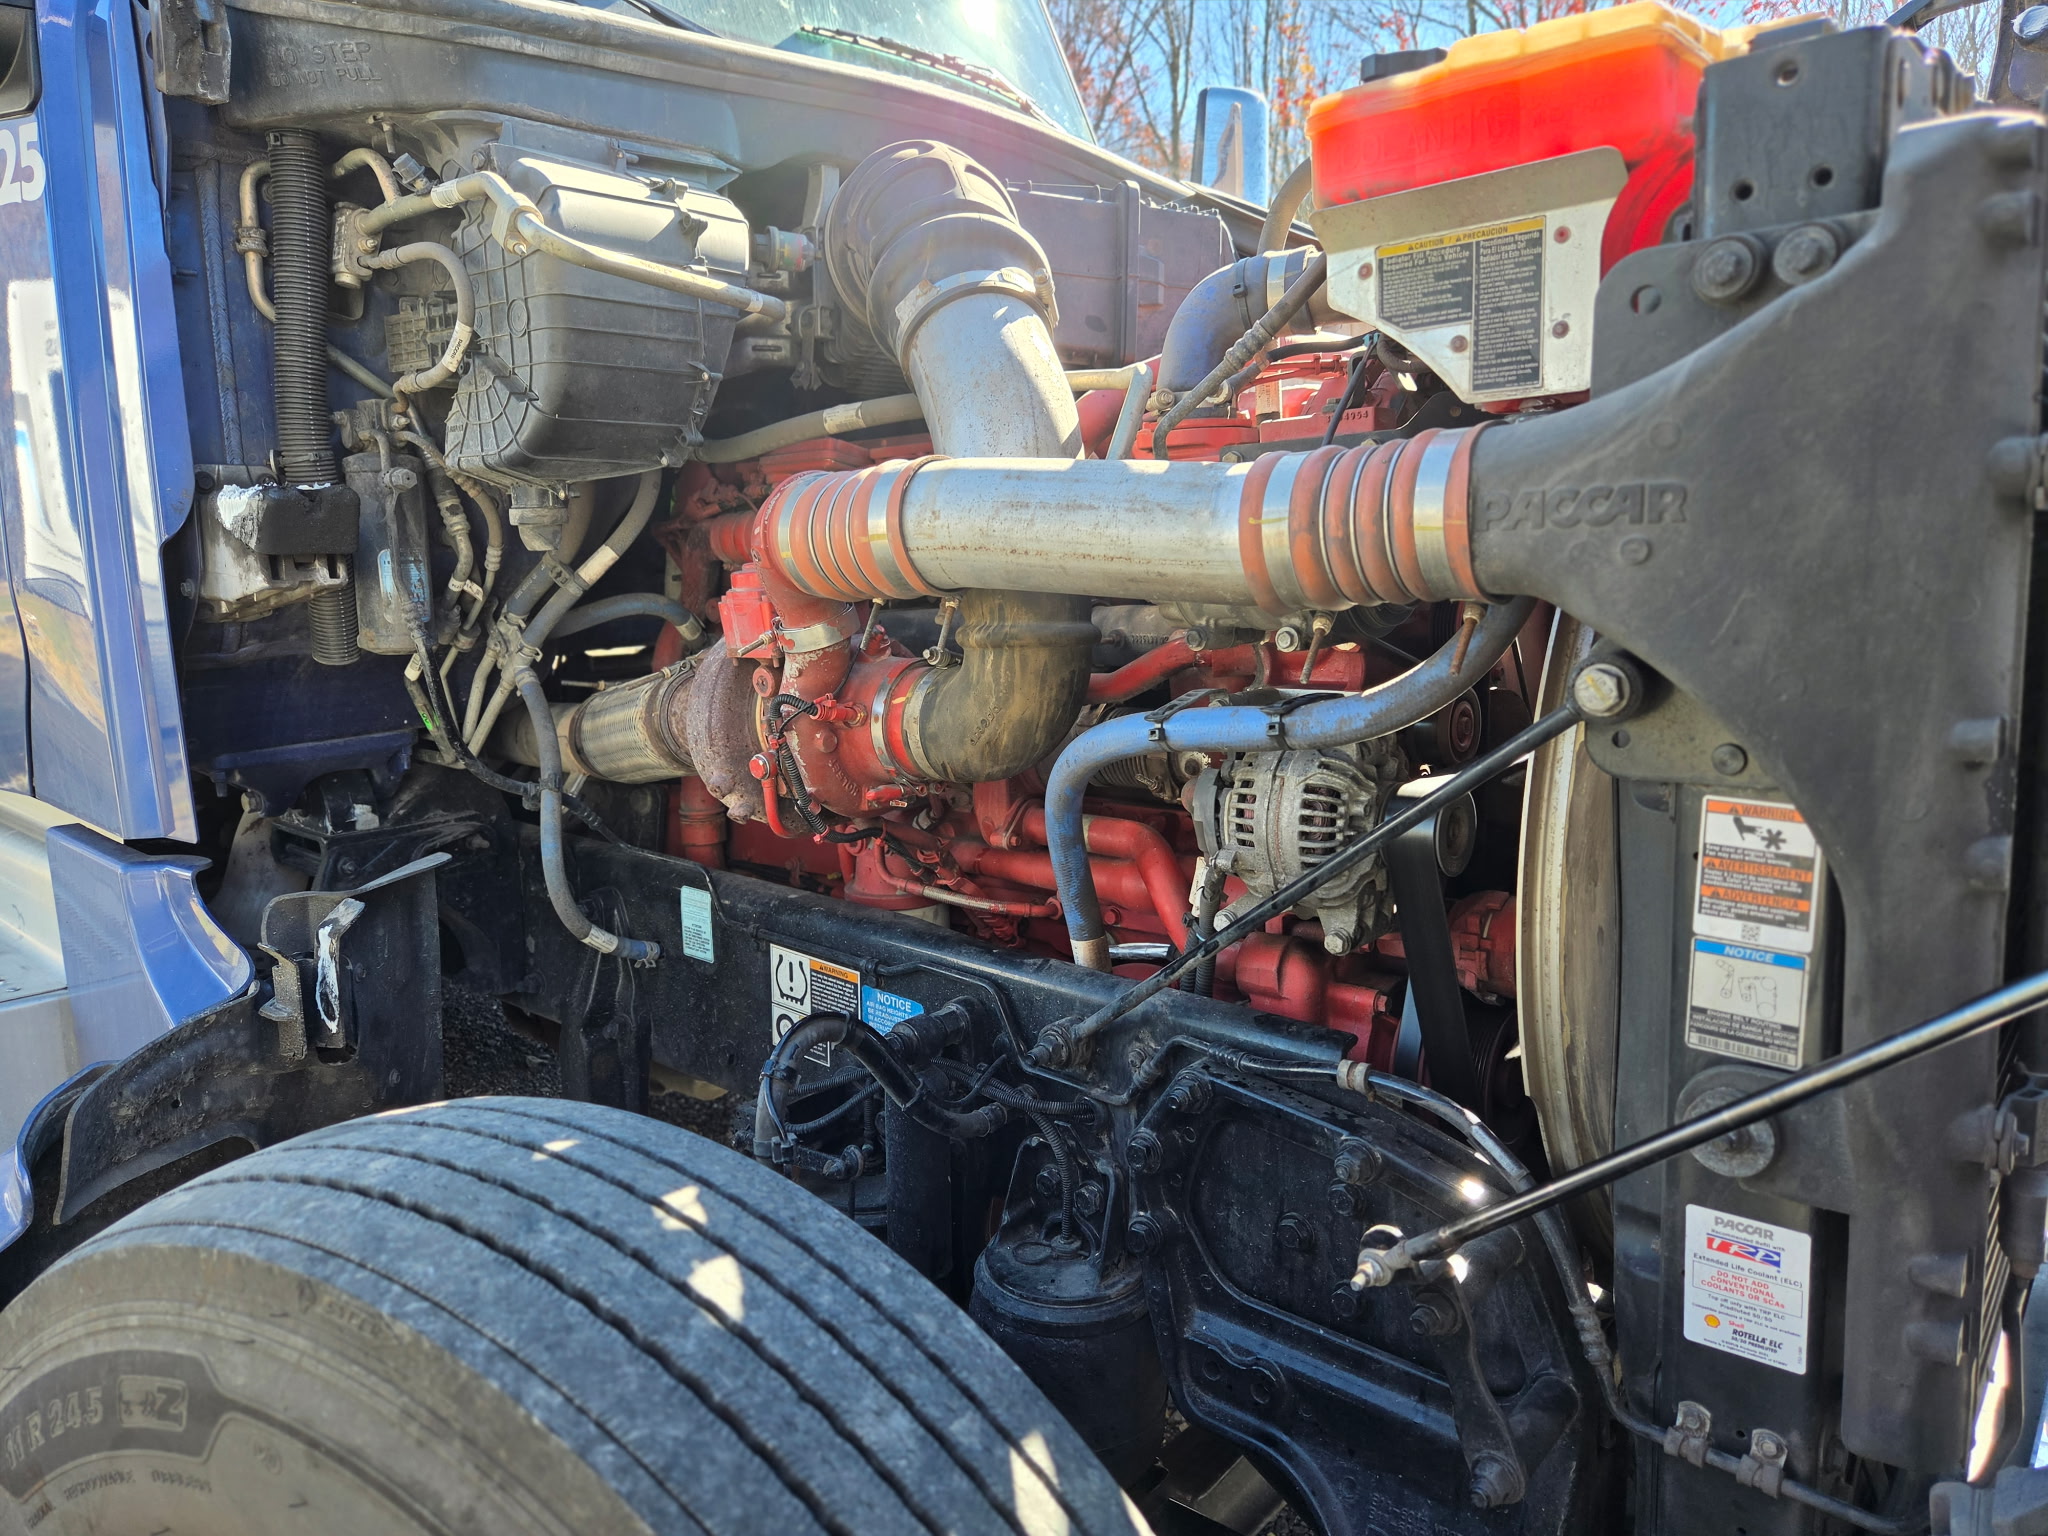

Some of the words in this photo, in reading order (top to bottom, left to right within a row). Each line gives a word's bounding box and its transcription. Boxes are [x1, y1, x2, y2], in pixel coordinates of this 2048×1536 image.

[311, 41, 372, 65] STEP
[298, 69, 326, 85] NOT
[336, 66, 383, 82] PULL
[1414, 238, 1445, 250] CAUTION
[1445, 250, 1470, 260] Vehicle
[1474, 482, 1688, 532] PACCAR
[1742, 805, 1796, 820] WARNING
[1720, 860, 1810, 881] AVERTISSEMENT
[1723, 891, 1799, 908] ADVERTENCIA
[1724, 945, 1775, 964] NOTICE
[824, 966, 848, 978] WARNING
[877, 992, 912, 1012] NOTICE
[1707, 1009, 1731, 1019] ENGINE
[1711, 1228, 1754, 1244] Recommended
[1714, 1216, 1774, 1241] PACCAR
[1712, 1238, 1780, 1262] TRP
[1693, 1252, 1729, 1267] Extended
[1731, 1262, 1745, 1272] Life
[1747, 1268, 1778, 1281] Coolant
[1780, 1277, 1803, 1289] (ELC)
[1716, 1270, 1729, 1278] DO
[1731, 1274, 1748, 1283] NOT
[1751, 1280, 1769, 1290] ADD
[1701, 1279, 1745, 1297] COOLANTS
[1747, 1293, 1760, 1302] OR
[1763, 1297, 1785, 1309] SCAs
[1710, 1275, 1775, 1299] CONVENTIONAL
[1708, 1293, 1719, 1302] Top
[1730, 1300, 1742, 1309] only
[1744, 1304, 1758, 1312] with
[1774, 1312, 1786, 1320] ELC
[1720, 1304, 1751, 1317] Prediluted
[1728, 1320, 1745, 1330] Shell
[1769, 1339, 1783, 1350] ELC
